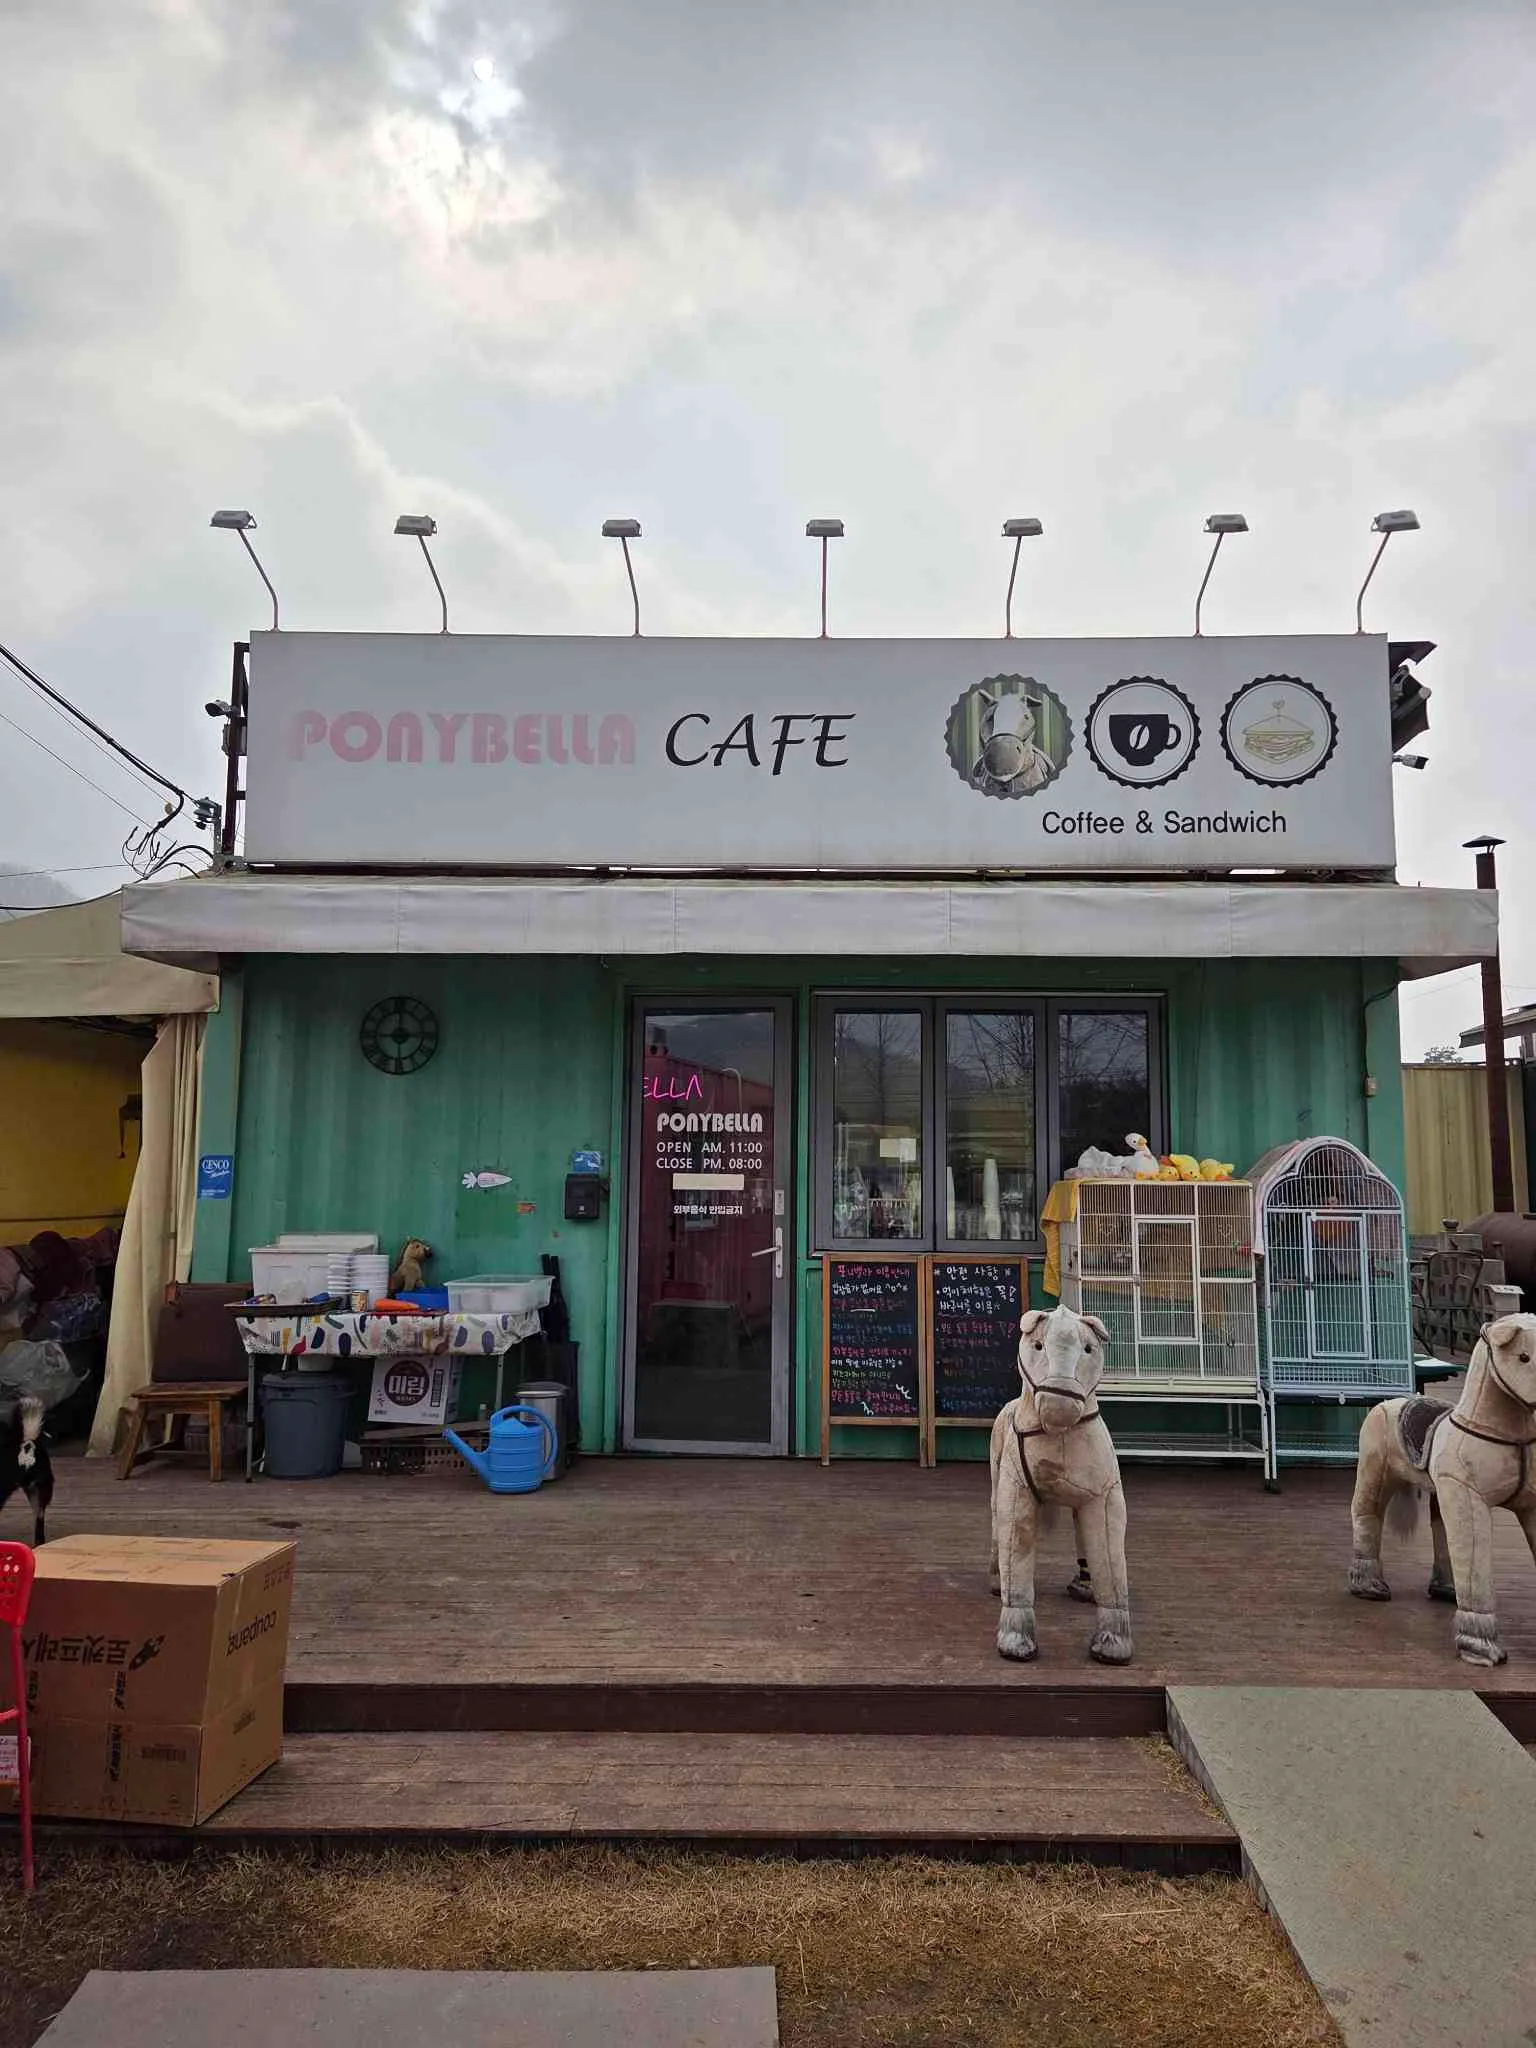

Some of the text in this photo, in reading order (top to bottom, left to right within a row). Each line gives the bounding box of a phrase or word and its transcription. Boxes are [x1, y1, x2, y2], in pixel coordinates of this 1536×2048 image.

[288, 710, 858, 776] PONYBELLA CAFE
[1041, 810, 1288, 835] Coffee & Sandwich
[656, 1112, 763, 1133] PONYBELLA
[656, 1142, 692, 1153] OPEN
[729, 1142, 763, 1153] 11:00
[202, 1159, 230, 1170] CESCO
[656, 1157, 693, 1169] CLOSE
[728, 1157, 763, 1169] 08:00
[388, 1375, 425, 1396] 미림
[226, 1610, 277, 1657] coupang
